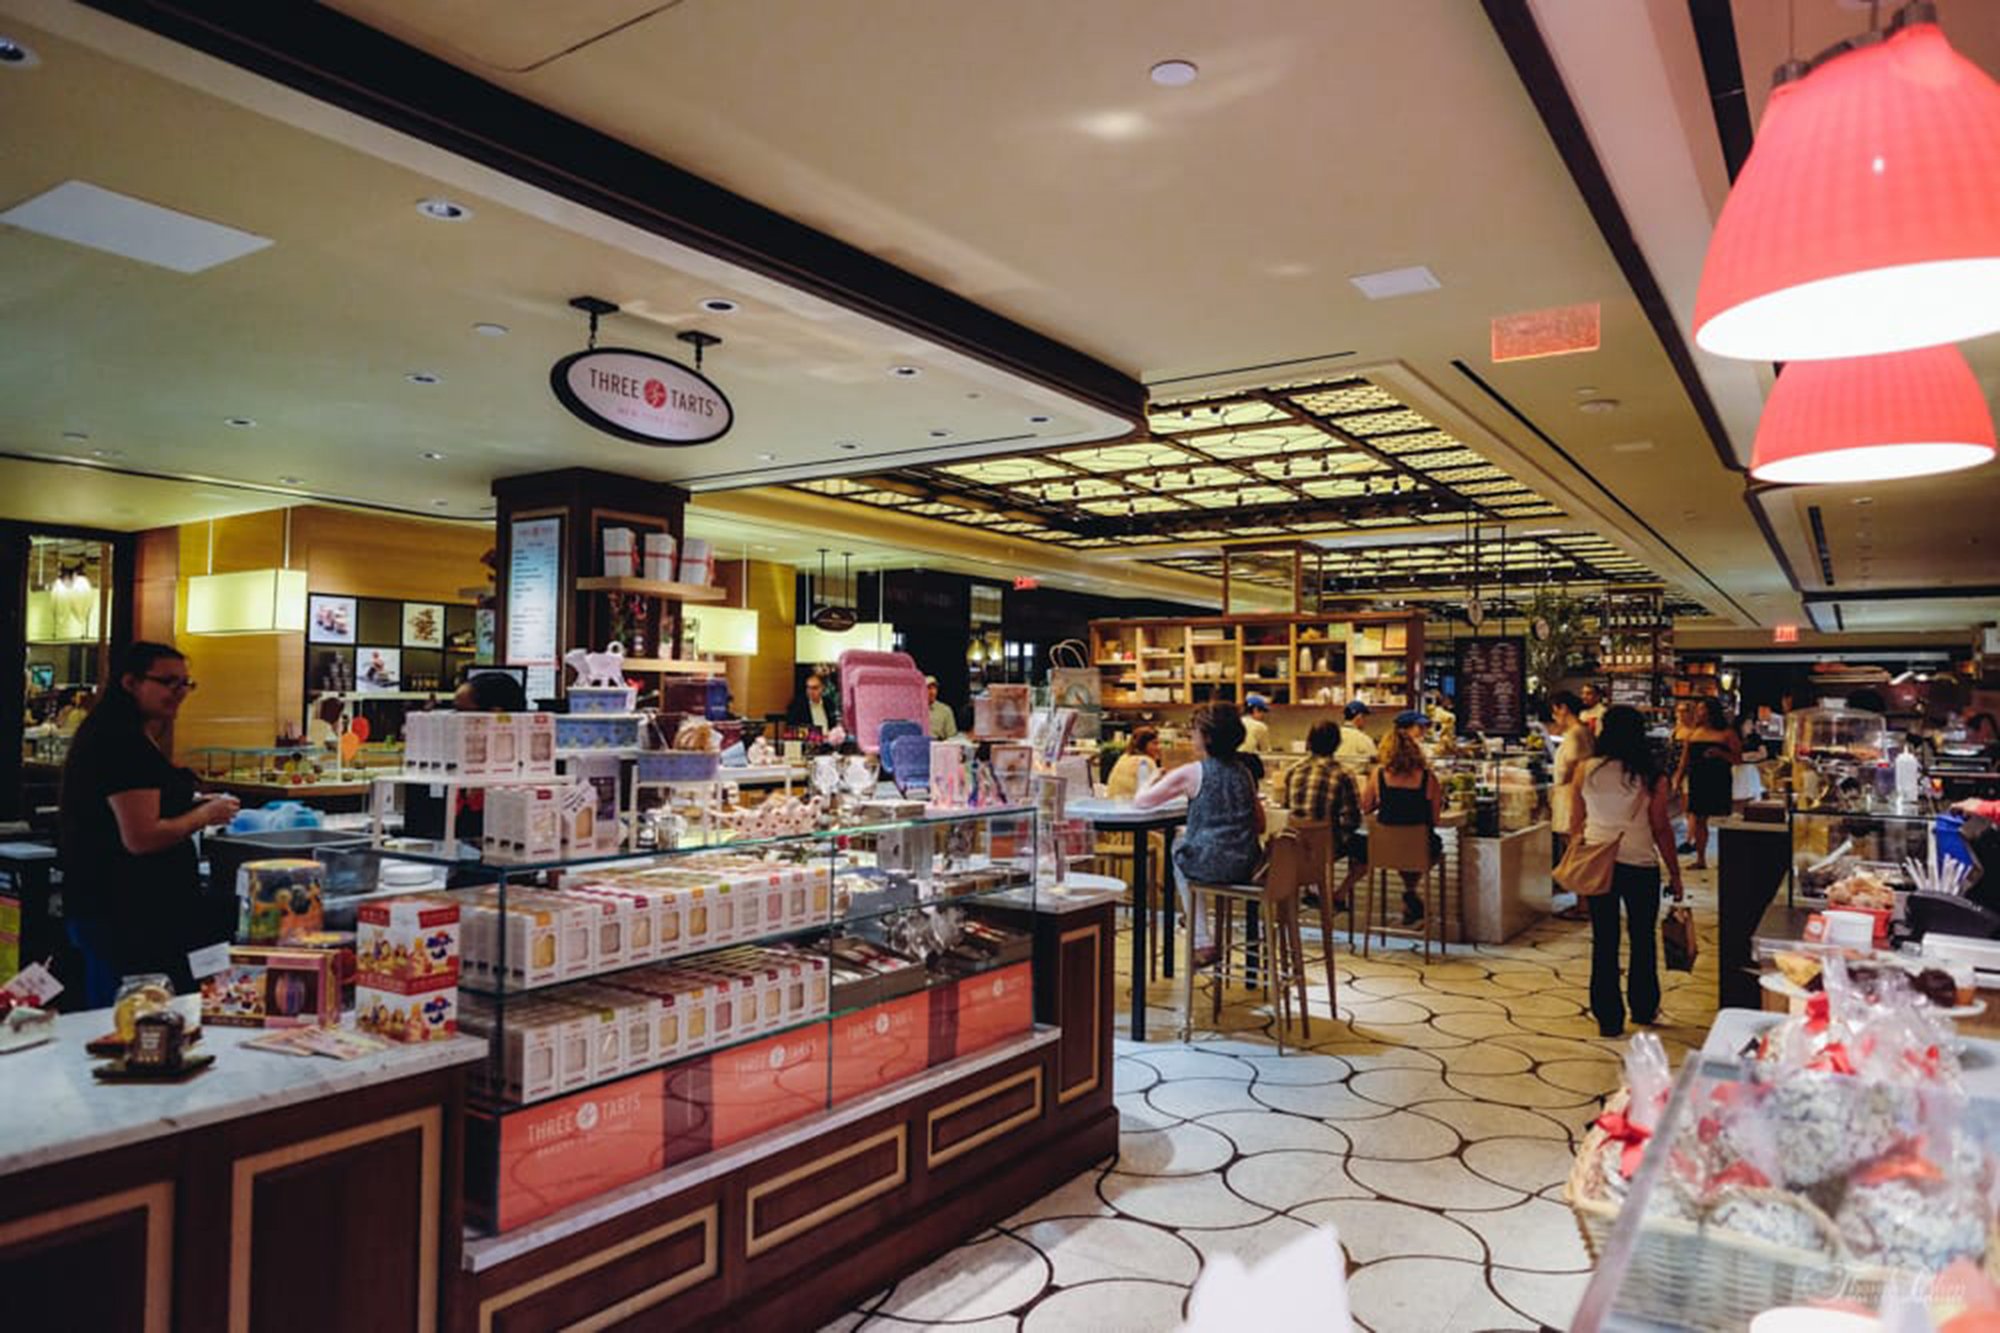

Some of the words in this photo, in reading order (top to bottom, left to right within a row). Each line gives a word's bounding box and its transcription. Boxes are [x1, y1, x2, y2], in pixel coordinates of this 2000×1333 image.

[589, 367, 640, 399] THREE
[671, 389, 715, 417] TARTS
[527, 1110, 576, 1146] THREE
[601, 1091, 641, 1121] TARTS
